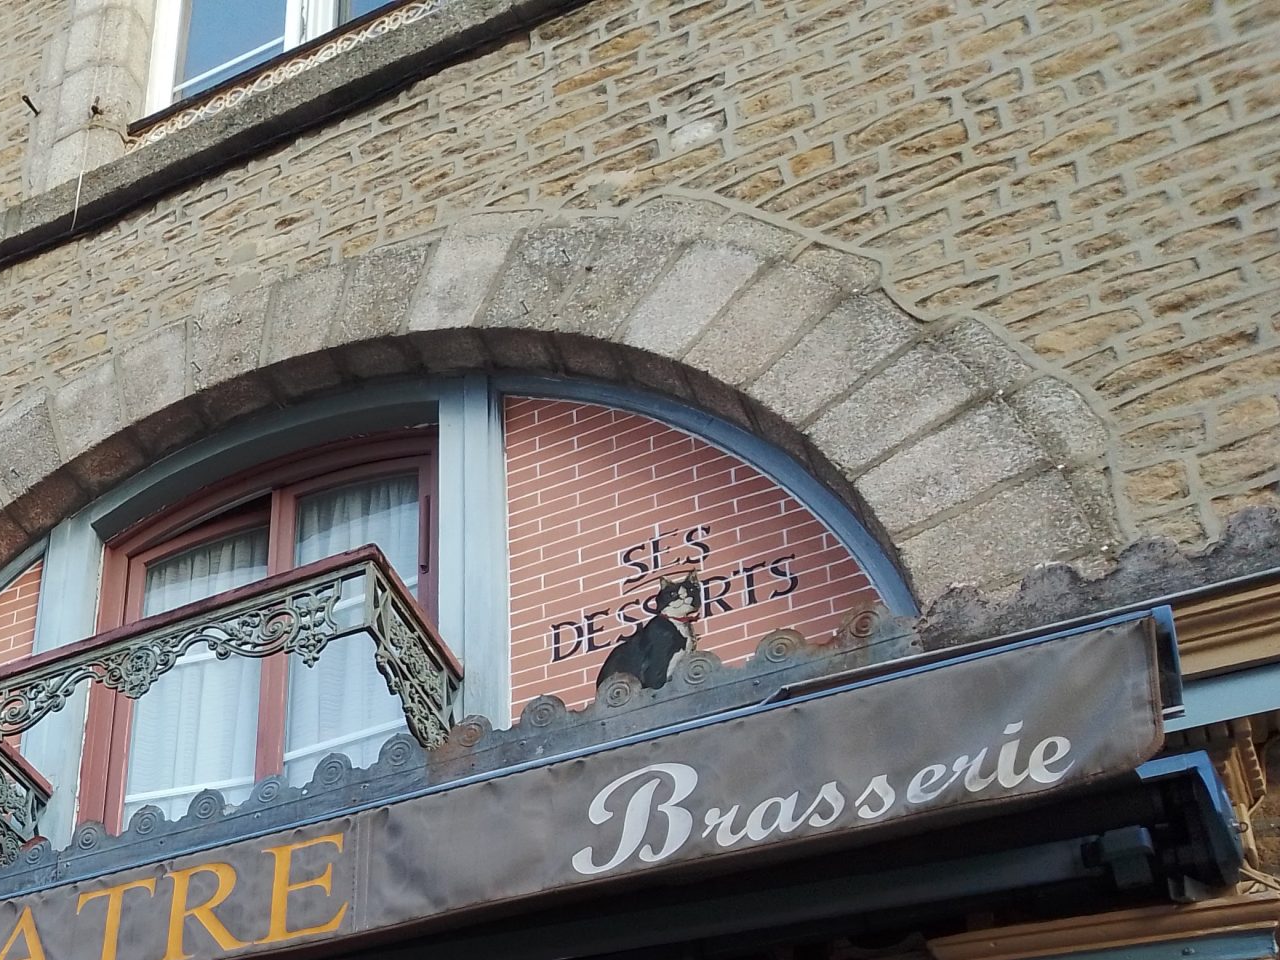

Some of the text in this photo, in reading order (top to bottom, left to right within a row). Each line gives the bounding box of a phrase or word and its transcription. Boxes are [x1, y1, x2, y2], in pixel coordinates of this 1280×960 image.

[551, 554, 799, 663] DESRTS
[621, 526, 711, 585] SES
[571, 720, 1075, 875] Brasserie
